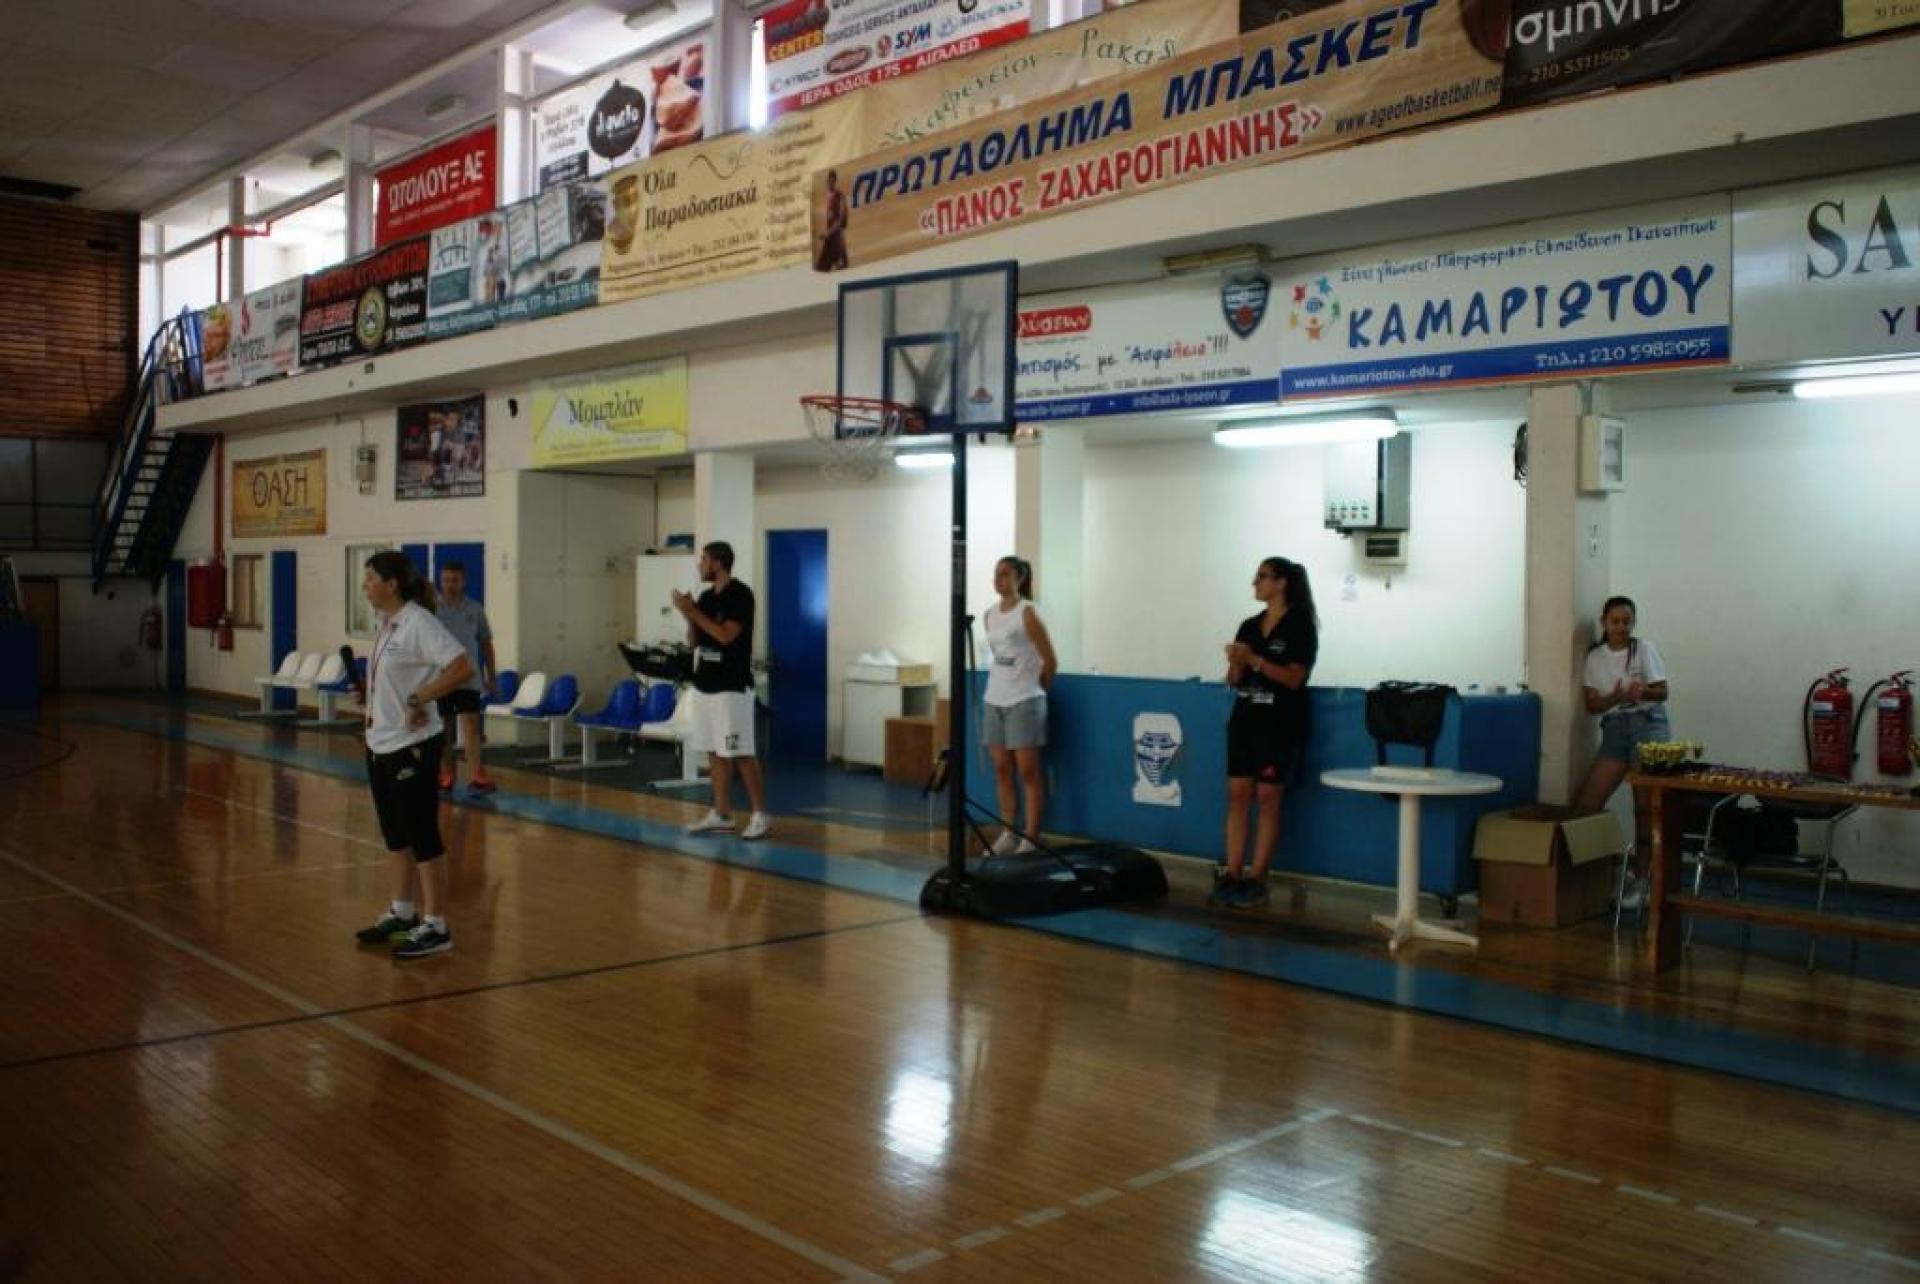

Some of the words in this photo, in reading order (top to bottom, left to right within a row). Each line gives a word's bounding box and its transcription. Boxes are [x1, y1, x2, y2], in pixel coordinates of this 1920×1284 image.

[896, 22, 932, 49] SYM
[852, 91, 1133, 209] ΠΡΩΤΑΘΛΗΜΑ
[1163, 0, 1437, 120] ΜΠΑΣΚΕΤ
[921, 179, 1024, 235] «ΠΑΝΟΣ
[1039, 103, 1322, 209] ΖΑΧΑΡΟΓΙΑΝΝΗΣ»
[646, 180, 758, 232] Παραδοσιακά
[1590, 346, 1626, 363] 210
[1630, 338, 1711, 362] 5982055
[1294, 363, 1454, 389] www.kamariotou.edu.gr
